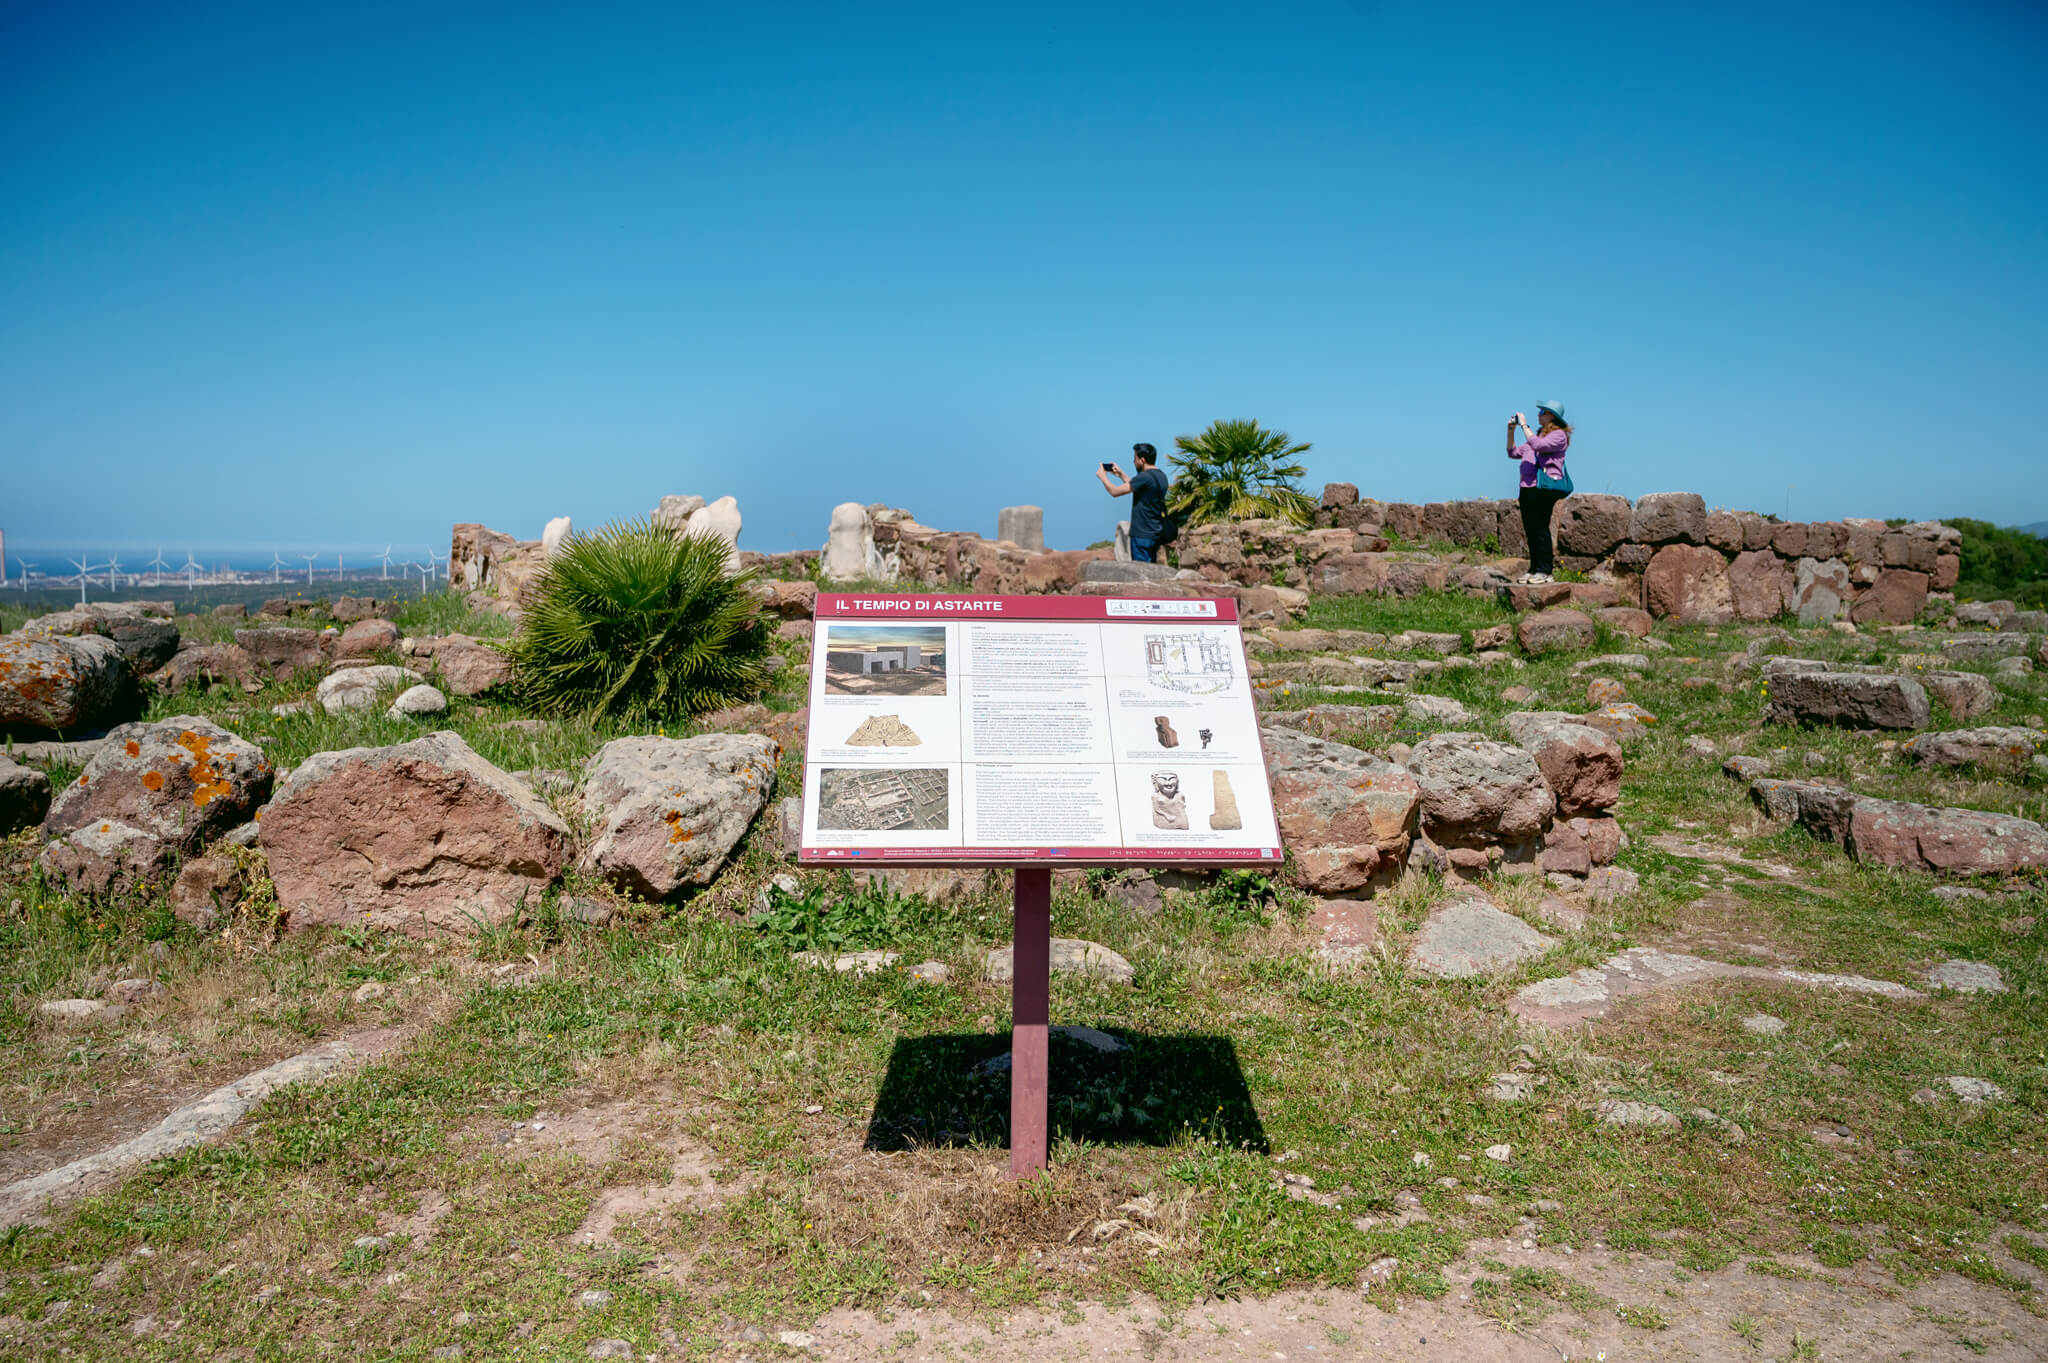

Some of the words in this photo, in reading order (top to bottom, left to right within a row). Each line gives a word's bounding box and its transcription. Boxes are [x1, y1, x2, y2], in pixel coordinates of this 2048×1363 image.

[836, 600, 849, 610] IL
[853, 600, 911, 610] TEMPIO
[915, 600, 930, 610] DI
[933, 600, 1004, 611] ASTARTE
